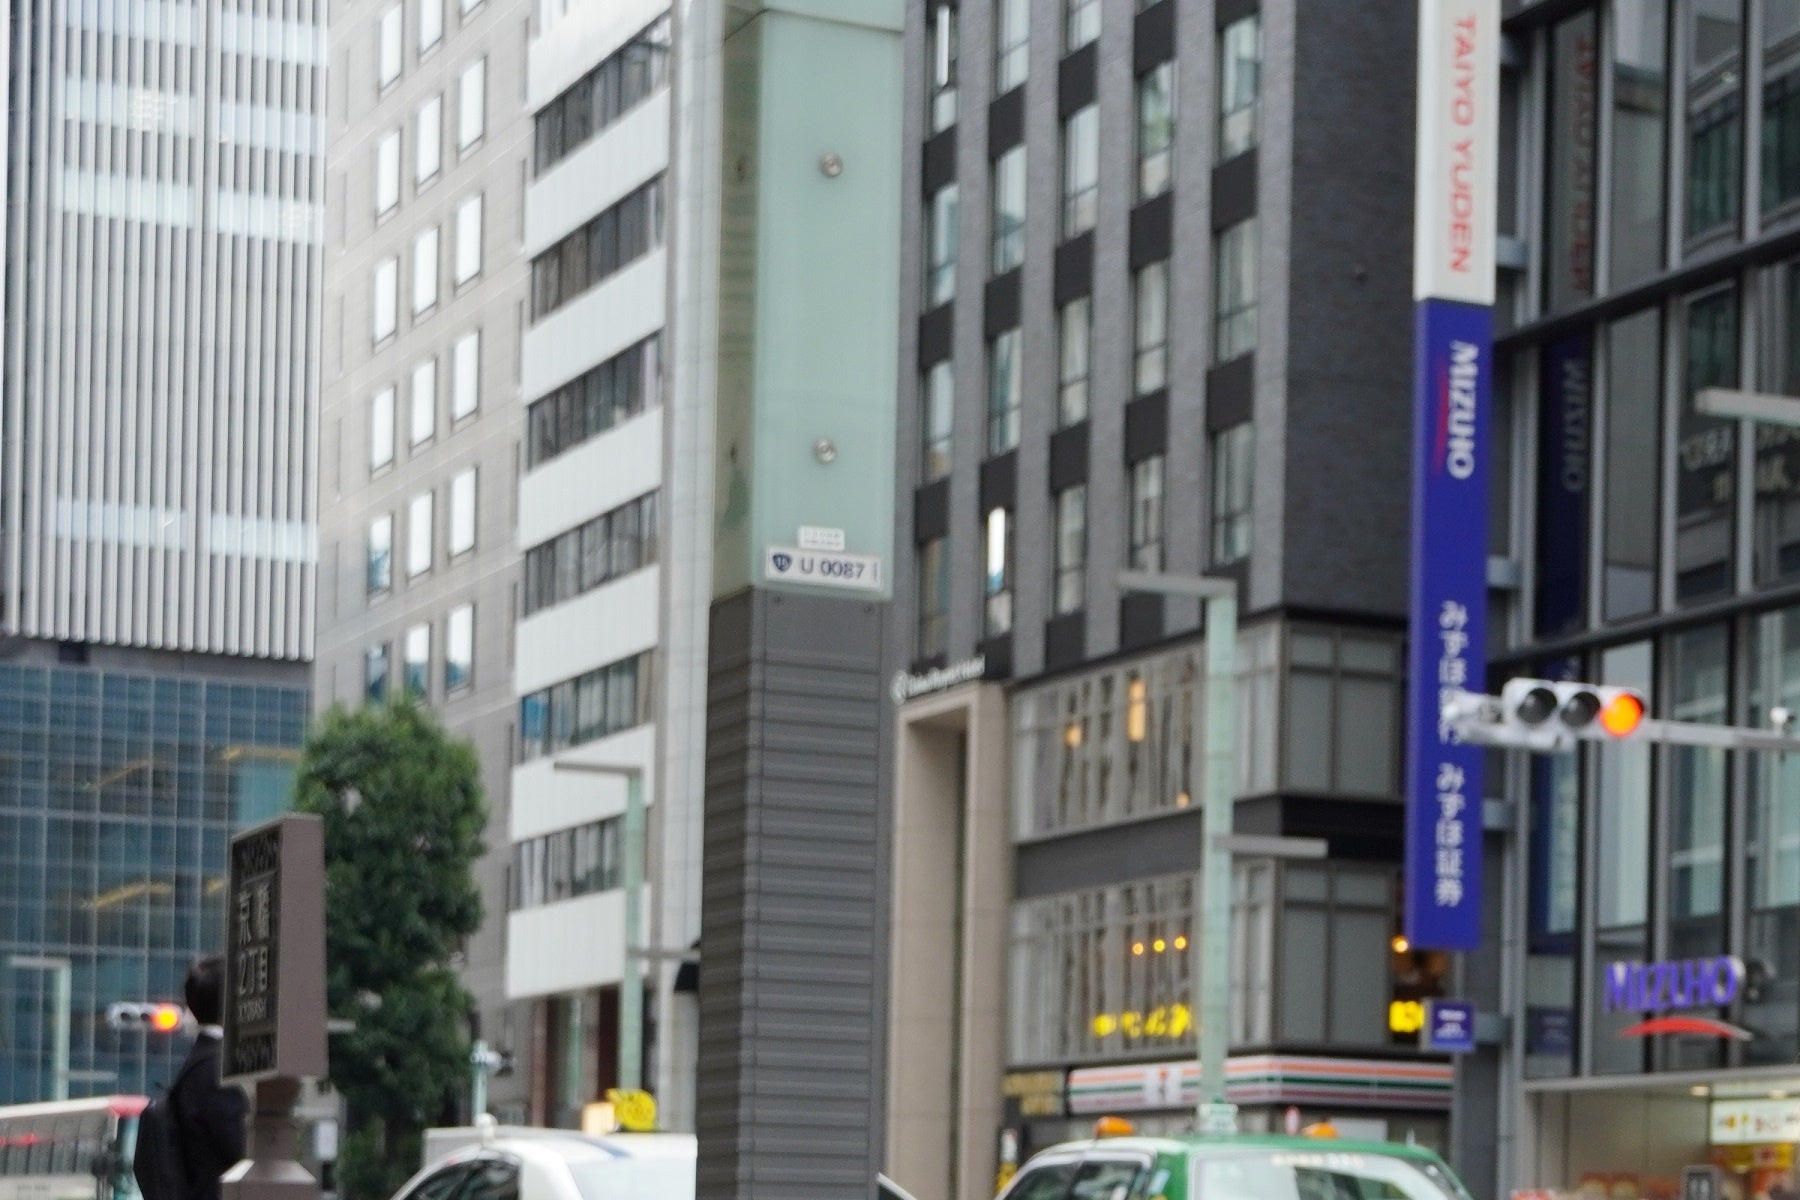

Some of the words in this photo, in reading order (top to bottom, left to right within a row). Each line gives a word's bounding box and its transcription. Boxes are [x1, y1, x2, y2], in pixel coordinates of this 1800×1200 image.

[1453, 14, 1477, 127] TAIYO
[1450, 138, 1474, 274] YUDEN
[1447, 339, 1479, 480] MIZUHO
[800, 557, 815, 575] U
[820, 559, 866, 580] 0087
[1435, 762, 1466, 908] みずほ証券
[1604, 955, 1740, 1015] MIZUHO
